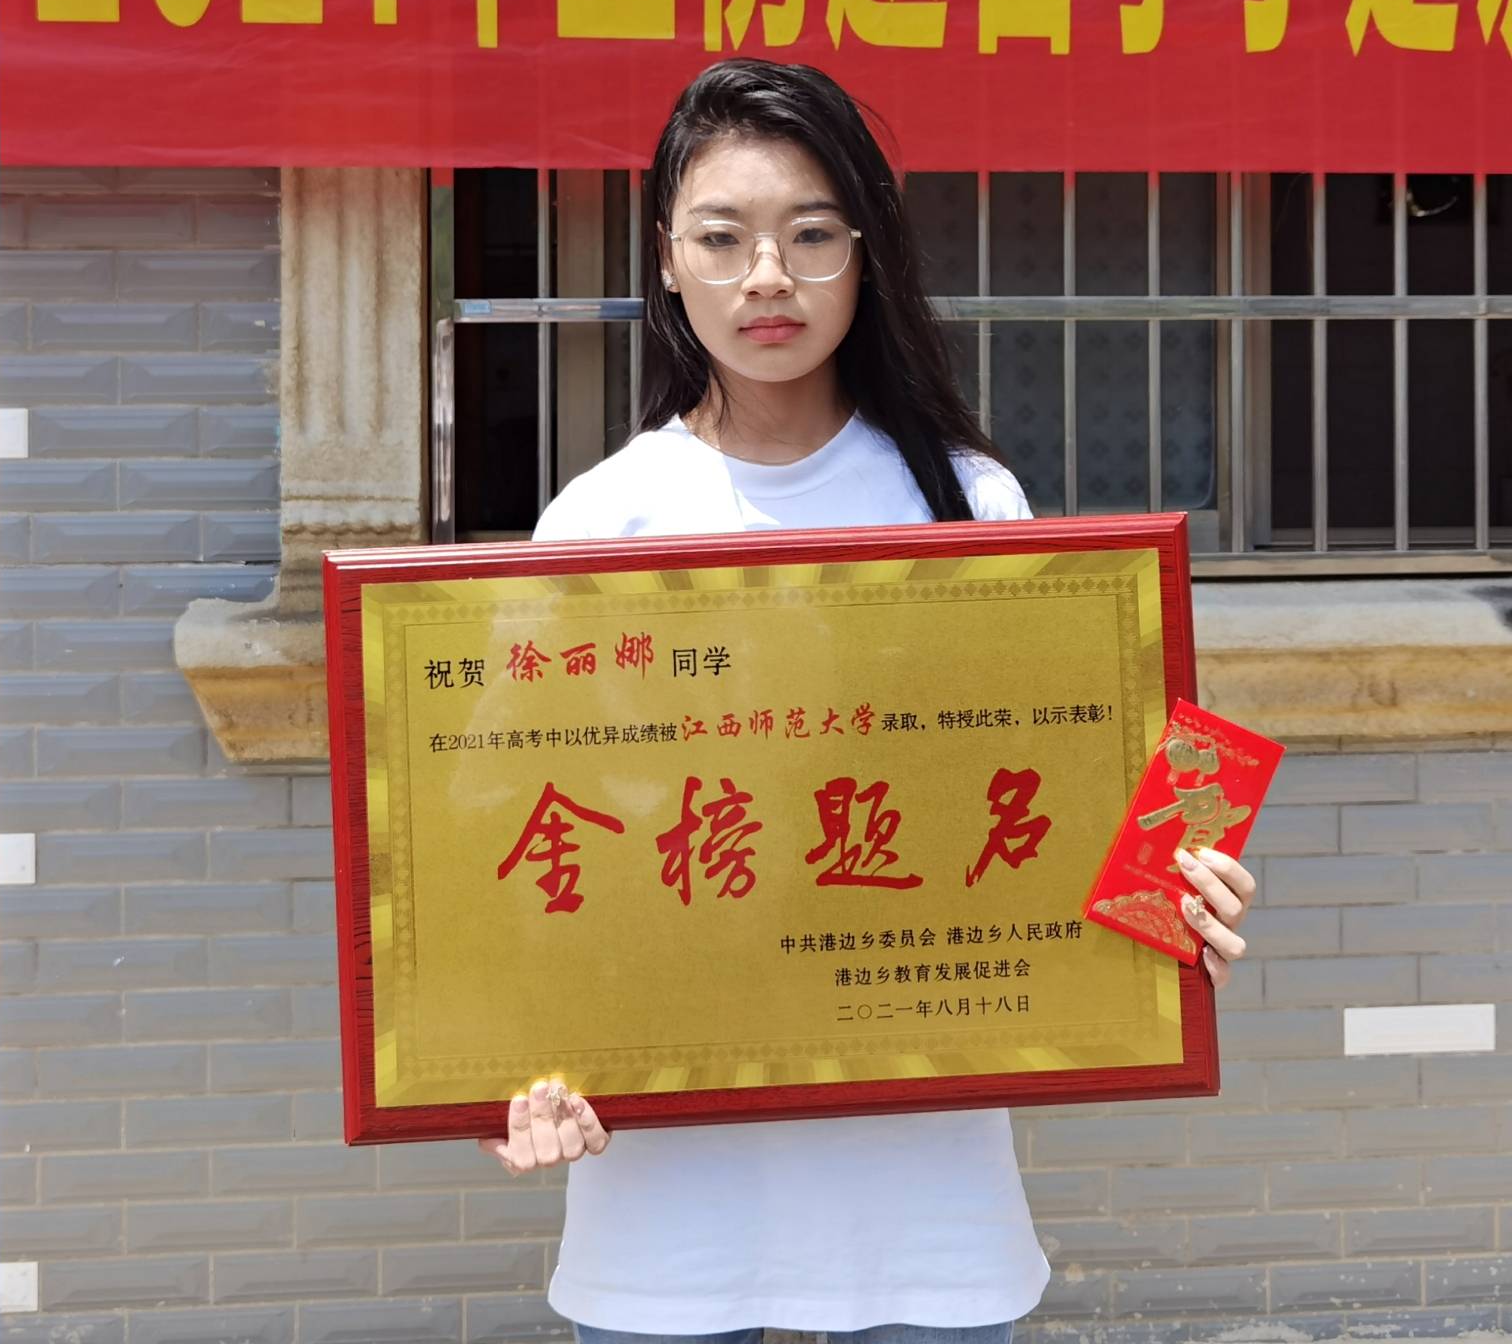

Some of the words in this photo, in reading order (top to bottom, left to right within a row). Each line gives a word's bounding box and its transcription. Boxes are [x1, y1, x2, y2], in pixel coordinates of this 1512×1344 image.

[424, 658, 485, 689] 祝贺
[506, 632, 654, 683] 徐丽娜
[672, 646, 731, 677] 同学
[497, 767, 1052, 913] 金榜题名
[780, 928, 936, 954] 中共港边乡委员会
[946, 920, 1083, 945] 港边乡人民政府
[835, 958, 1031, 987] 港边乡教育发展促进会
